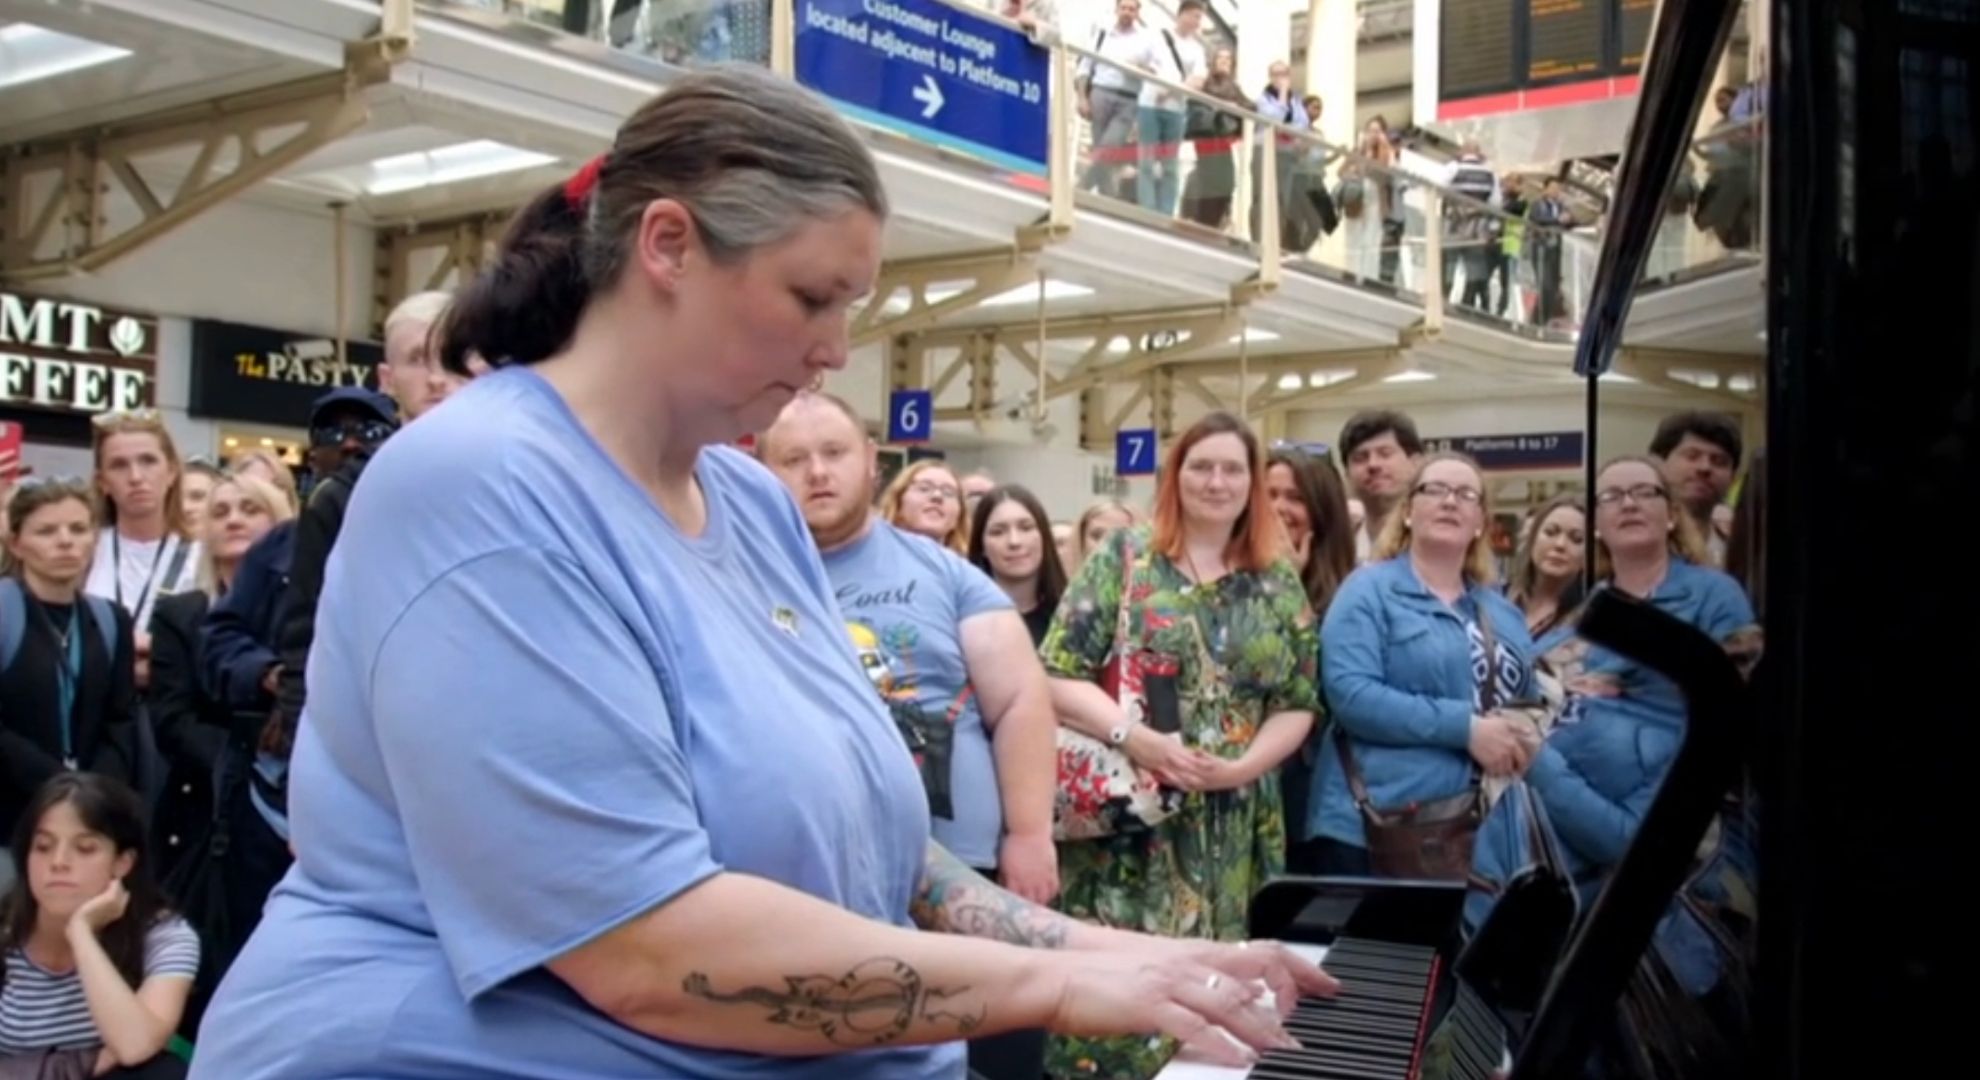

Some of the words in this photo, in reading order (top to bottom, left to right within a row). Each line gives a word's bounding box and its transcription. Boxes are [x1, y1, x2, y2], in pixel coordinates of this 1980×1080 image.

[863, 0, 940, 37] Customer
[941, 20, 995, 60] Lounge
[806, 3, 868, 44] located
[870, 30, 937, 68] adjacent
[939, 53, 956, 74] to
[959, 58, 1020, 97] Platform
[1023, 80, 1041, 103] 10
[0, 352, 146, 413] FFEE
[235, 354, 264, 377] The
[267, 352, 370, 388] PASTY
[900, 399, 919, 433] 6
[1128, 437, 1144, 467] 7
[1465, 437, 1515, 450] Platforms
[1529, 437, 1541, 449] to
[1544, 436, 1559, 449] 17
